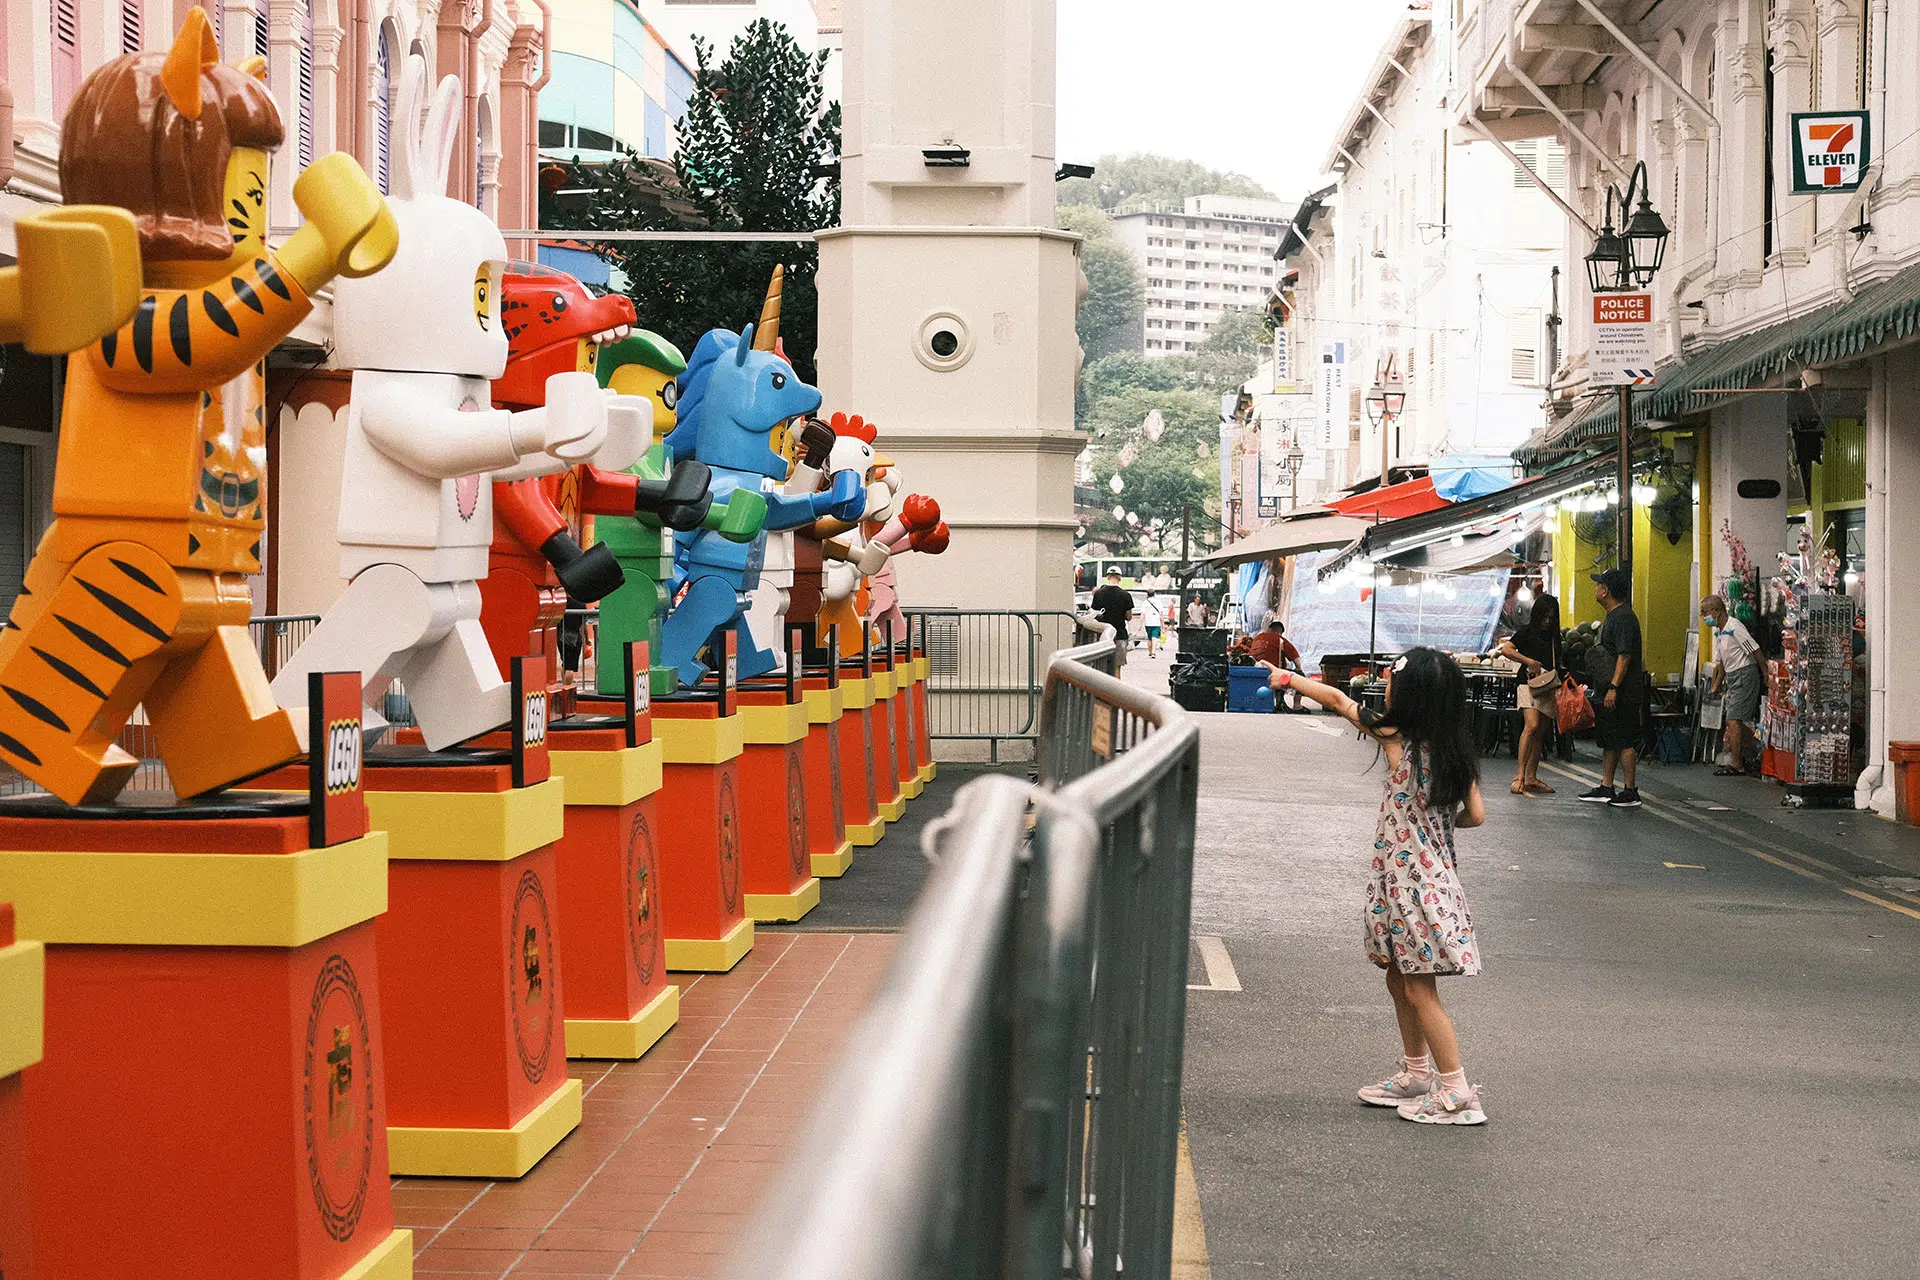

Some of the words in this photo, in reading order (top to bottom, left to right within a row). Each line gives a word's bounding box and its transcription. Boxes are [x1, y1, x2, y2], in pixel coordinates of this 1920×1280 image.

[1809, 123, 1853, 185] 7
[1600, 310, 1645, 320] NOTICE
[1601, 299, 1644, 308] POLICE
[635, 671, 649, 712] LEGO
[525, 694, 545, 745] LEGO
[327, 722, 360, 791] LEGO
